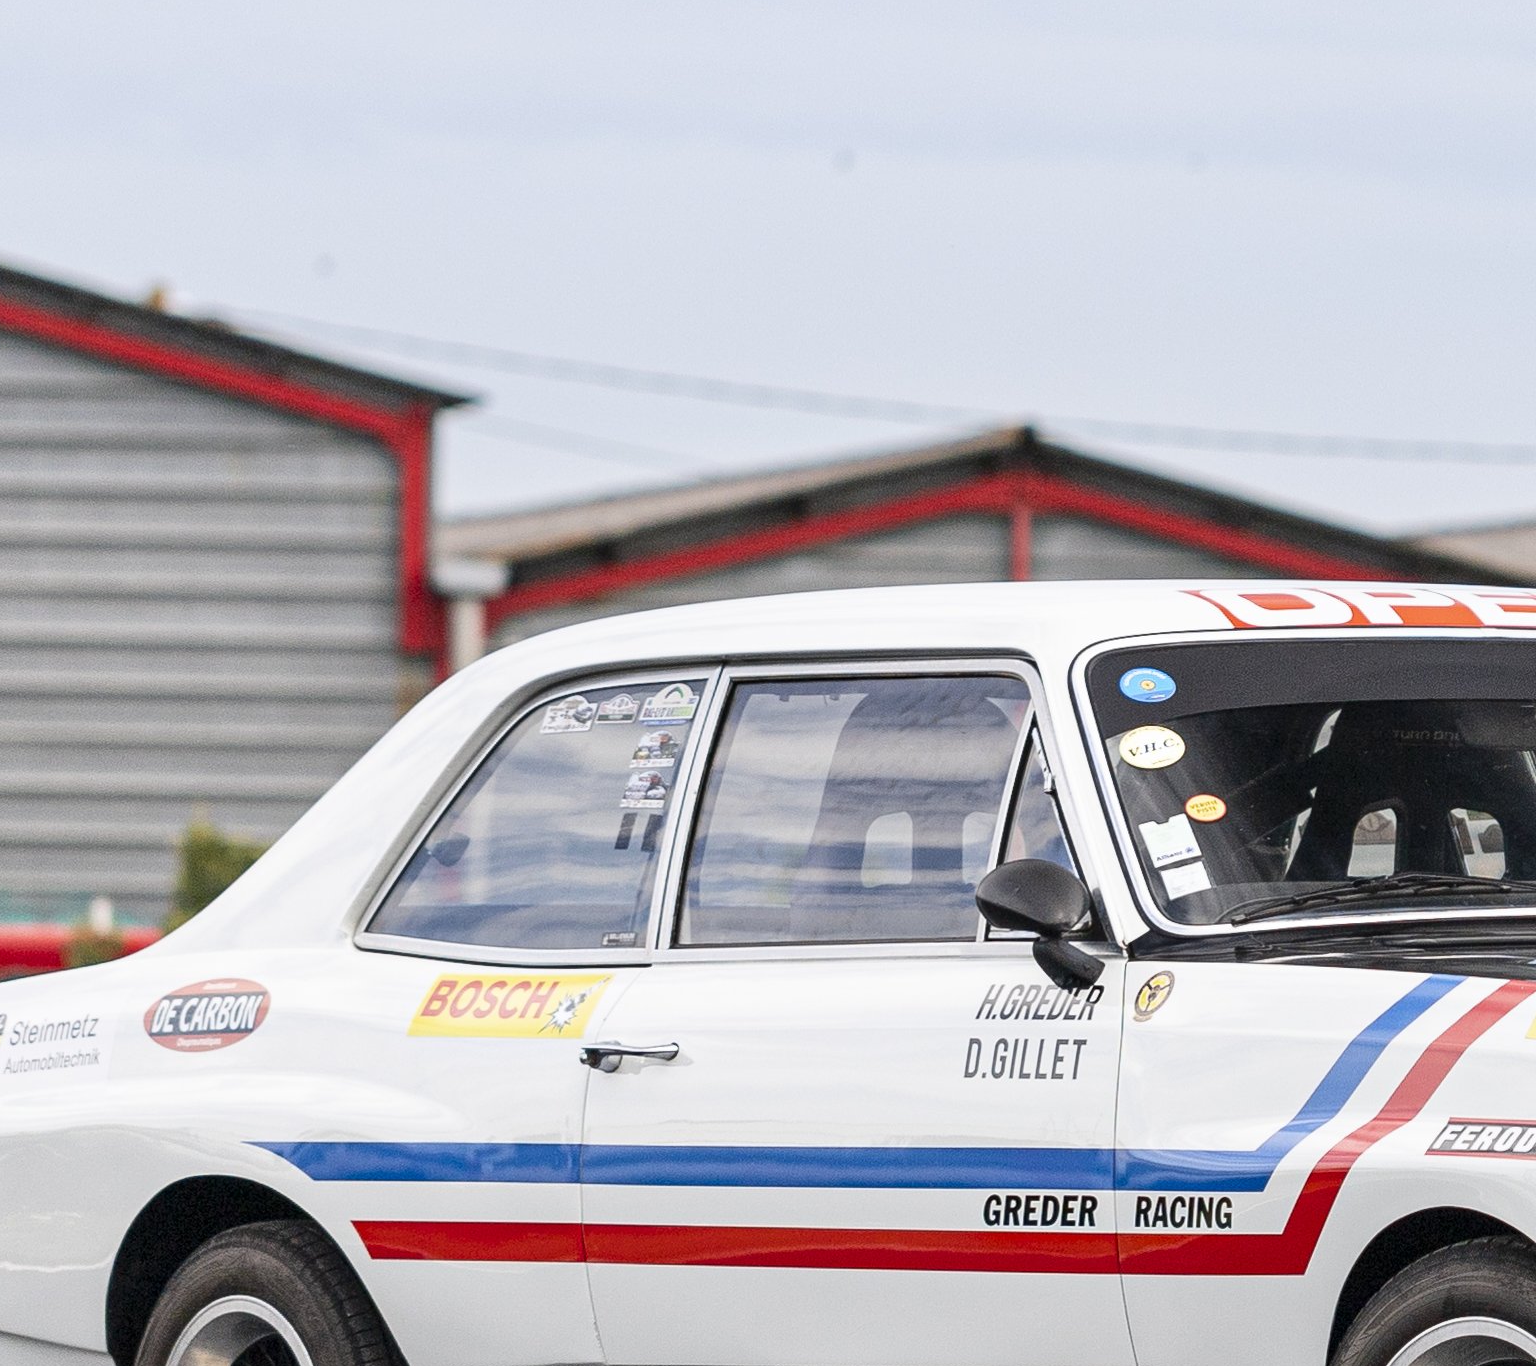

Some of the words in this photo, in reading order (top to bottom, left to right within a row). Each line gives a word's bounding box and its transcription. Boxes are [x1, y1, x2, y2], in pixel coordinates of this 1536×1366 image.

[151, 998, 183, 1033] DE
[179, 995, 263, 1032] CARBON
[421, 980, 561, 1020] BOSCH
[975, 984, 1105, 1021] H.GREDER
[9, 1014, 99, 1046] Steinmetz
[4, 1048, 101, 1075] Automobiltechnik
[964, 1038, 1087, 1080] D.GILLET
[983, 1194, 1098, 1227] GREDER
[1135, 1196, 1232, 1229] RACING
